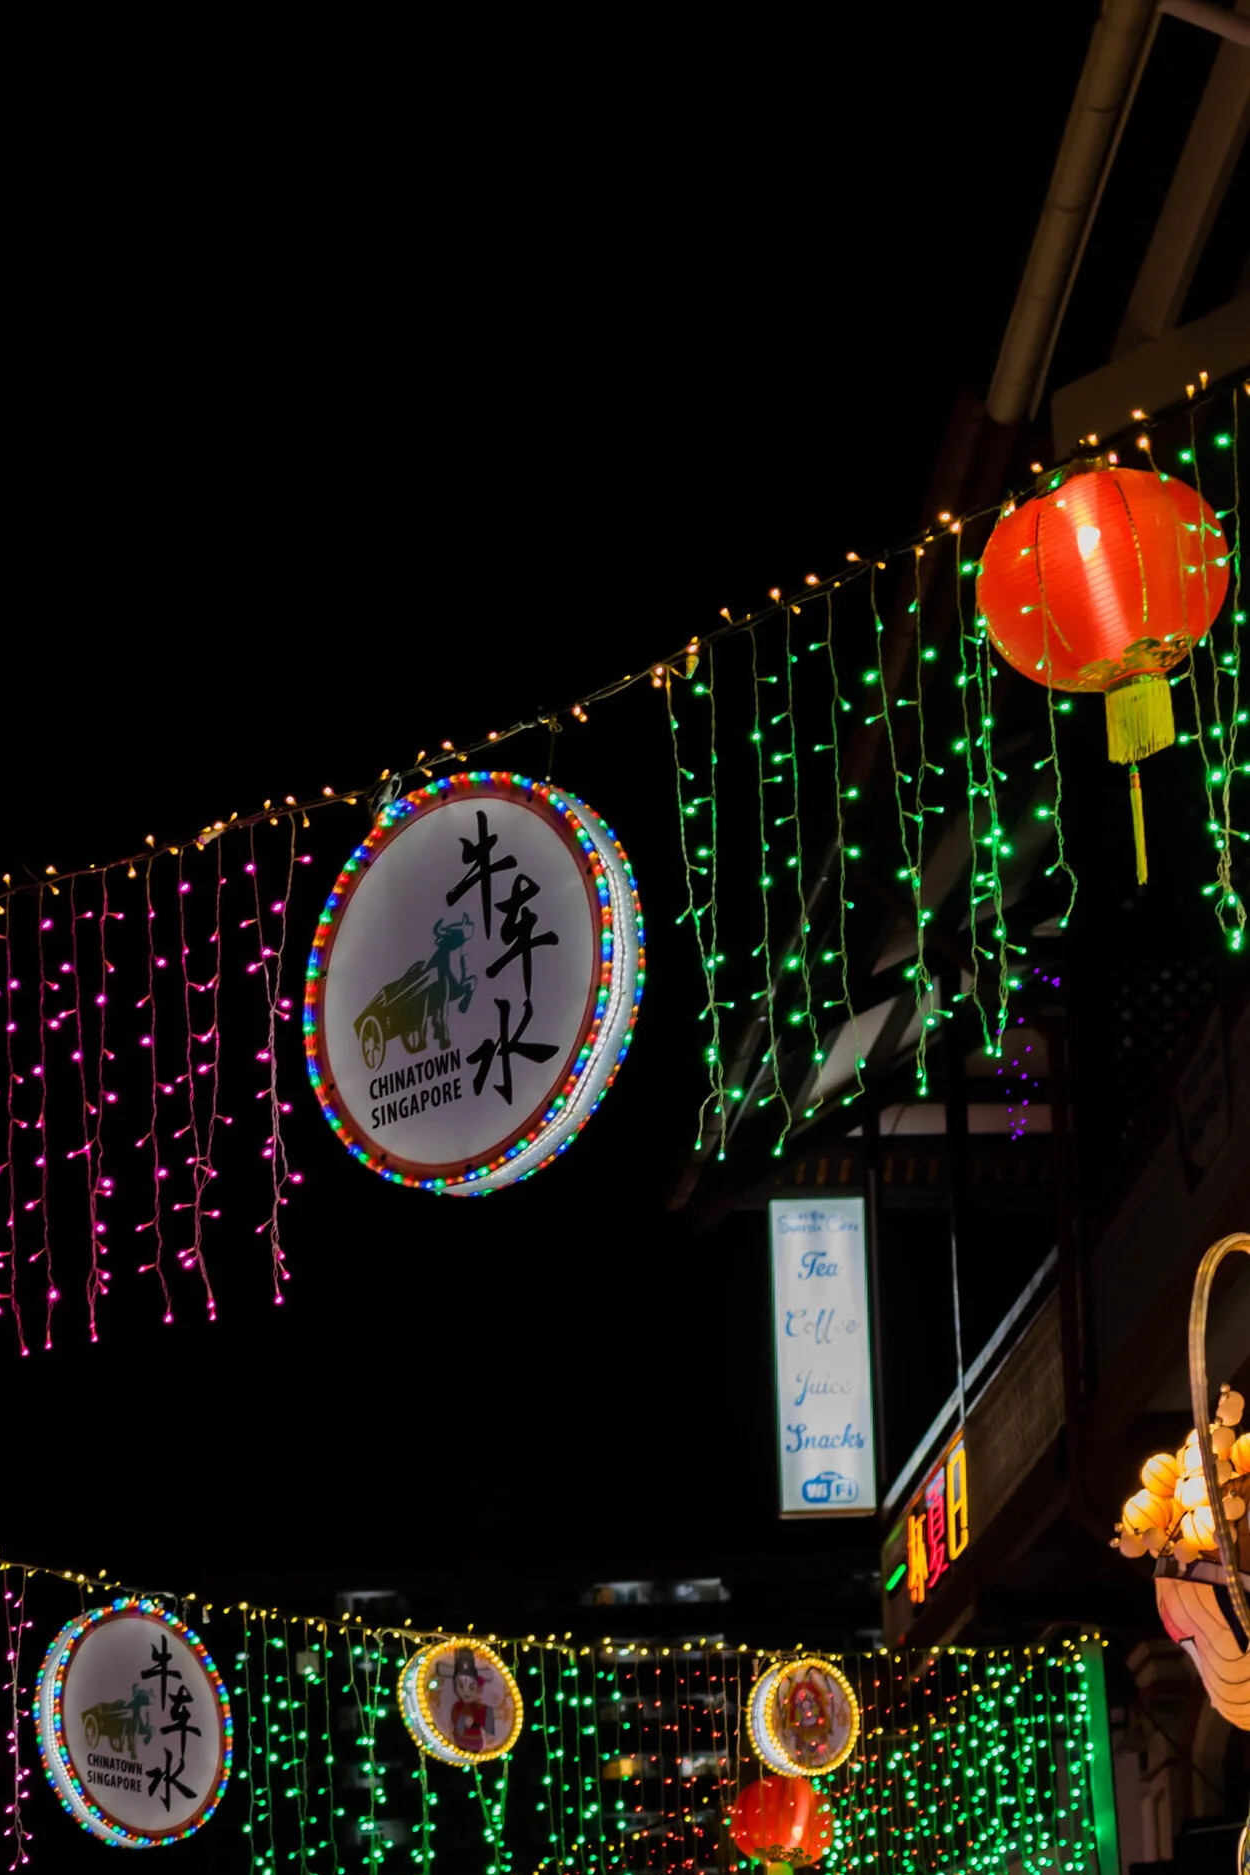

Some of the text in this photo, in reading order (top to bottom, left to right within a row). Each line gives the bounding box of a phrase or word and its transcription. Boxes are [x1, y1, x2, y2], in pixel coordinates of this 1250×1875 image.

[446, 810, 559, 1106] 牛车水
[368, 1048, 462, 1101] CHINATOWN
[371, 1077, 463, 1130] SINGAPORE
[797, 1250, 839, 1280] Tea
[786, 1423, 865, 1454] Snacks
[141, 1634, 202, 1813] 牛车水
[86, 1752, 143, 1776] CHINATOWN
[86, 1771, 143, 1793] SINGAPORE
